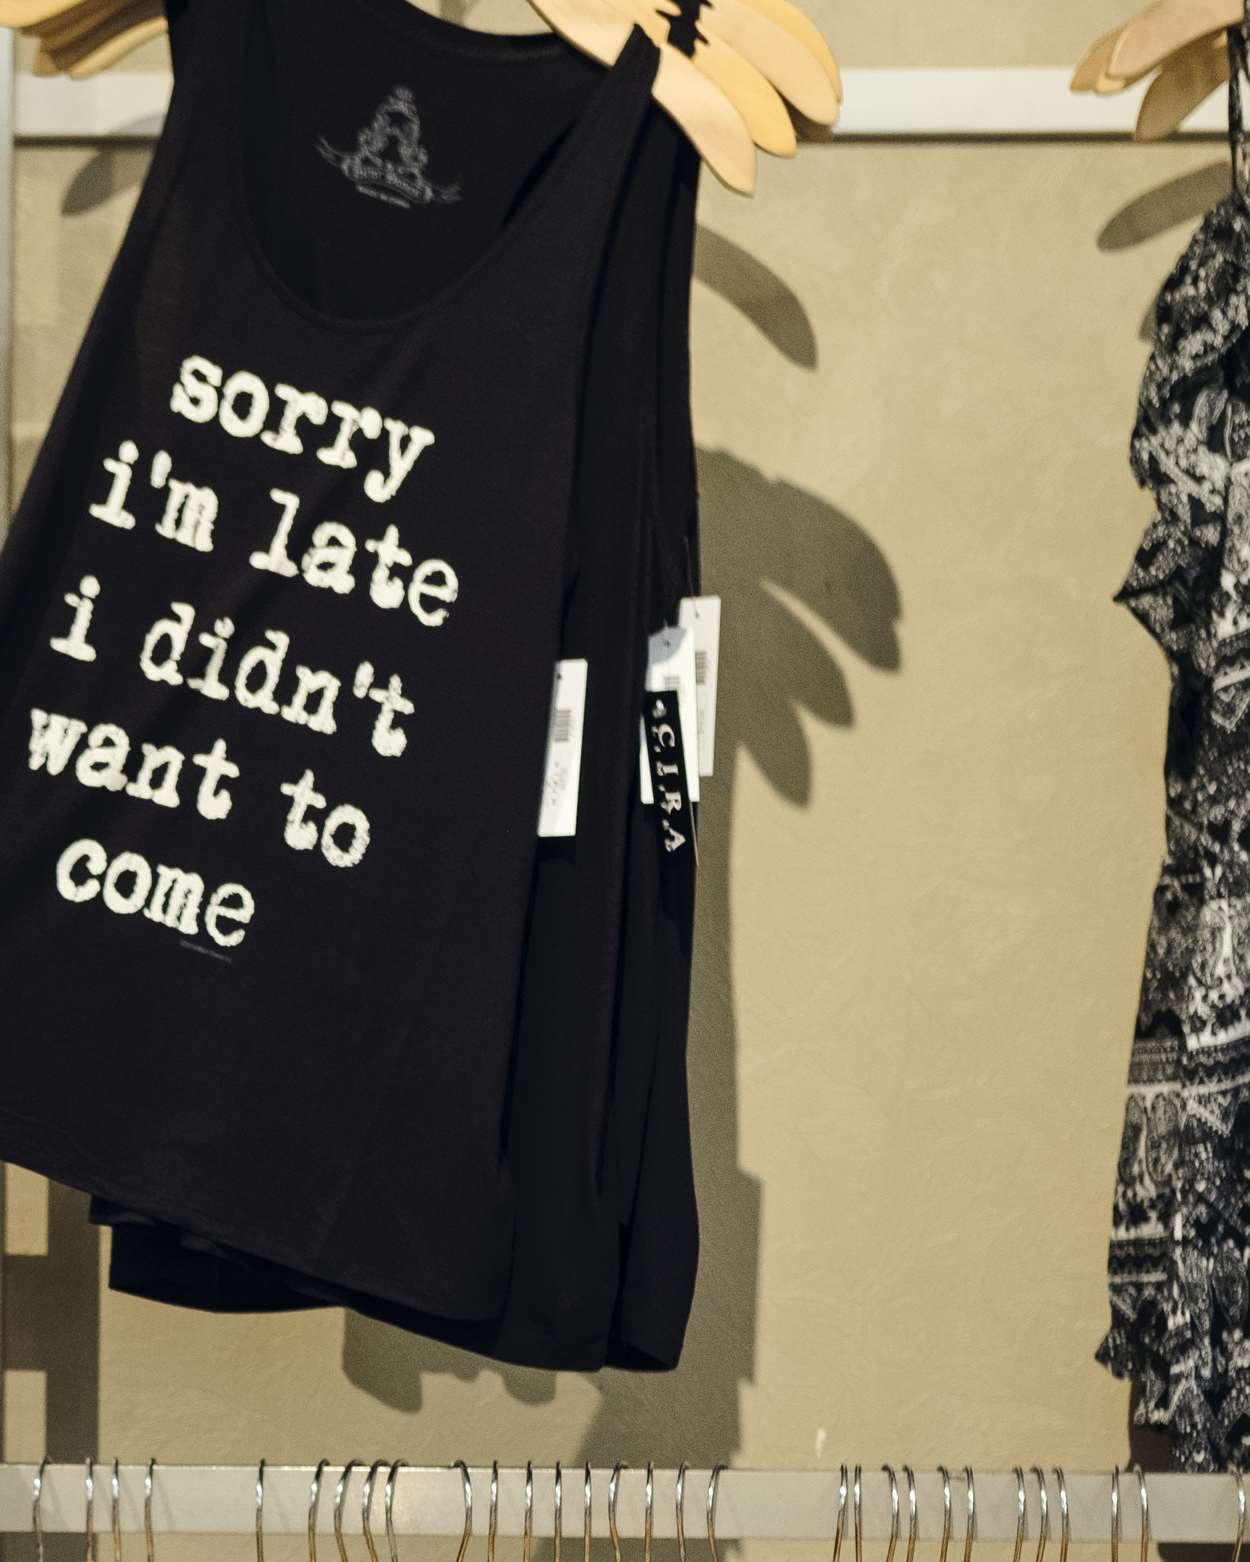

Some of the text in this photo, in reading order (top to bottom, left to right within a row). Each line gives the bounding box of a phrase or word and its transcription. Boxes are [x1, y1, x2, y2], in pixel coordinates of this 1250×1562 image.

[170, 355, 435, 503] sorry
[89, 440, 458, 627] i'm late
[50, 575, 414, 757] i didn't
[29, 708, 370, 867] want to
[56, 839, 255, 947] come
